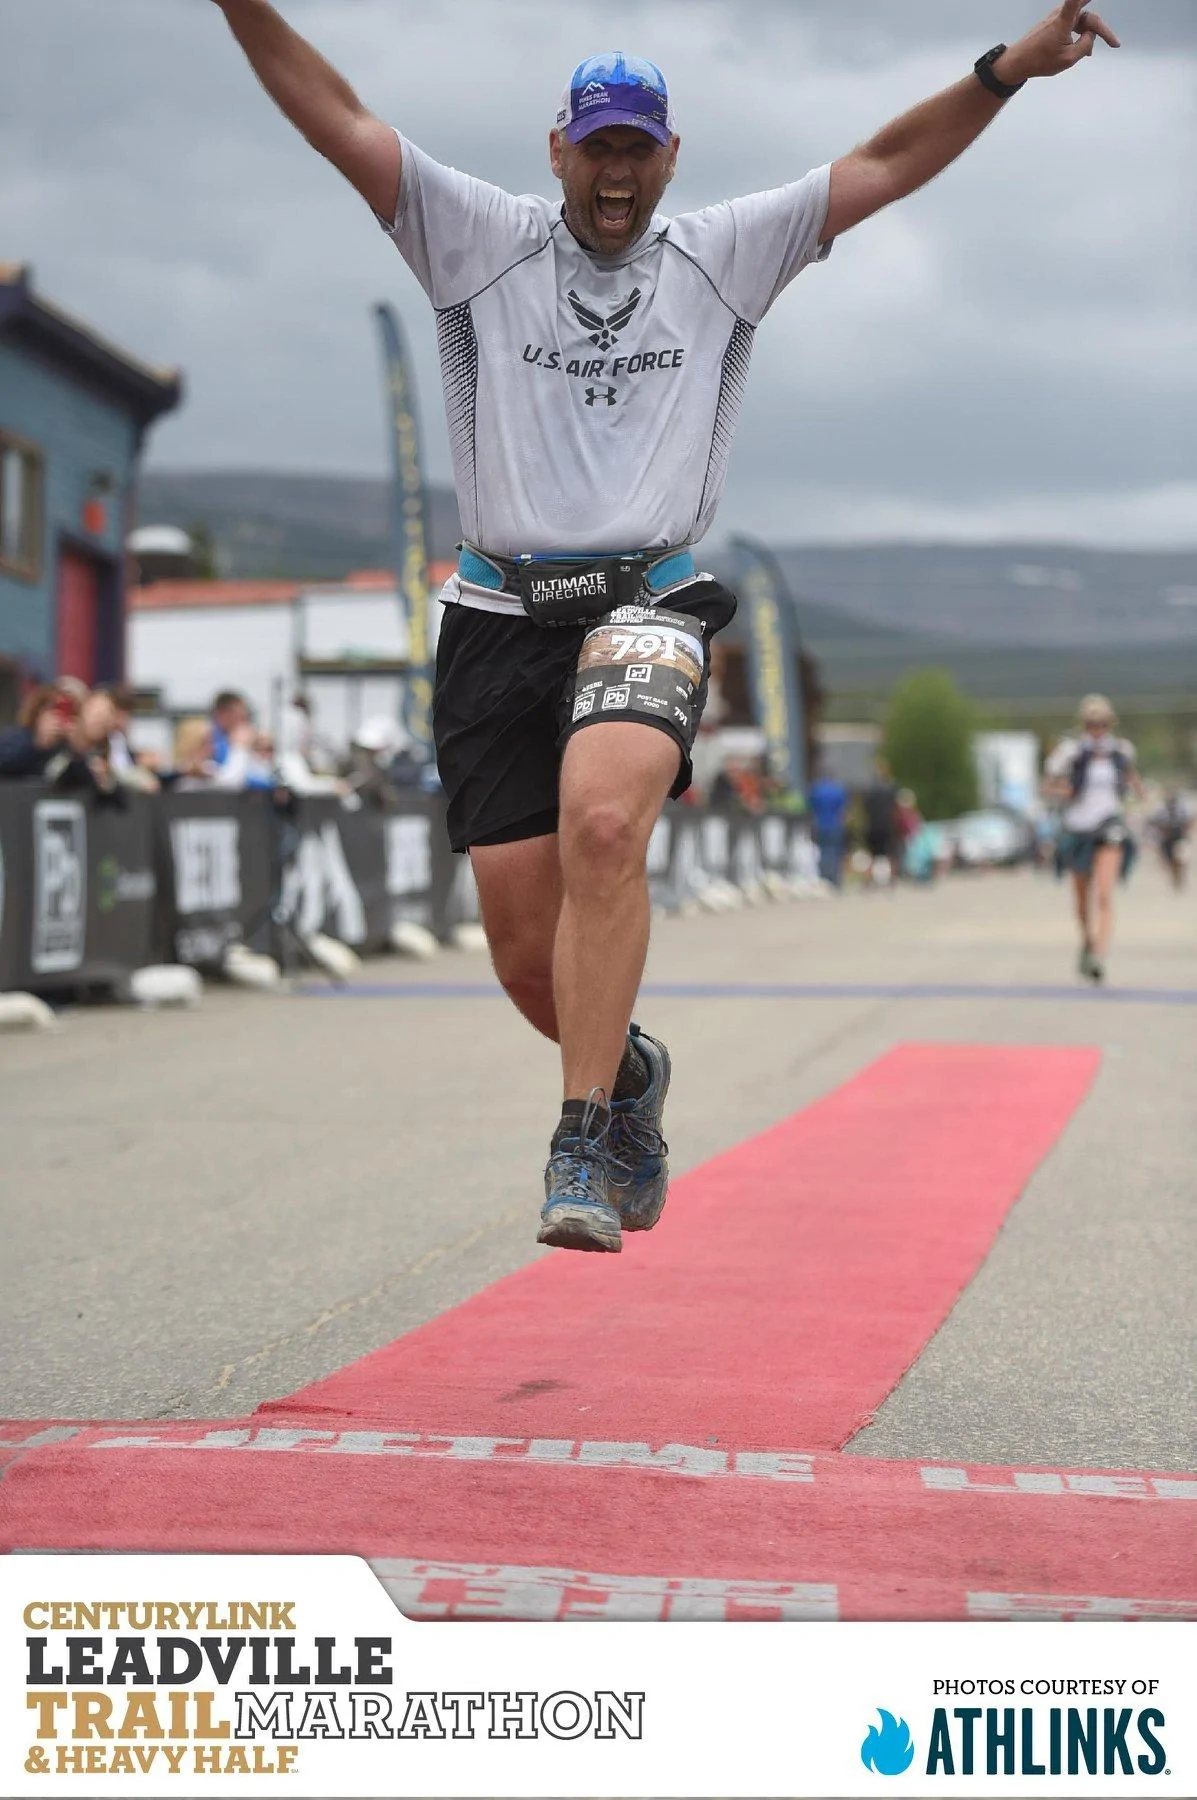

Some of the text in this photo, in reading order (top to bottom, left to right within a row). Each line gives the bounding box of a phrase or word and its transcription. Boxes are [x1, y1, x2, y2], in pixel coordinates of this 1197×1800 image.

[566, 360, 605, 378] AIR
[612, 348, 685, 377] FORCE
[531, 572, 606, 592] ULTIMATE
[532, 585, 607, 602] DIRECTION
[610, 634, 677, 662] 791
[674, 706, 688, 727] 791
